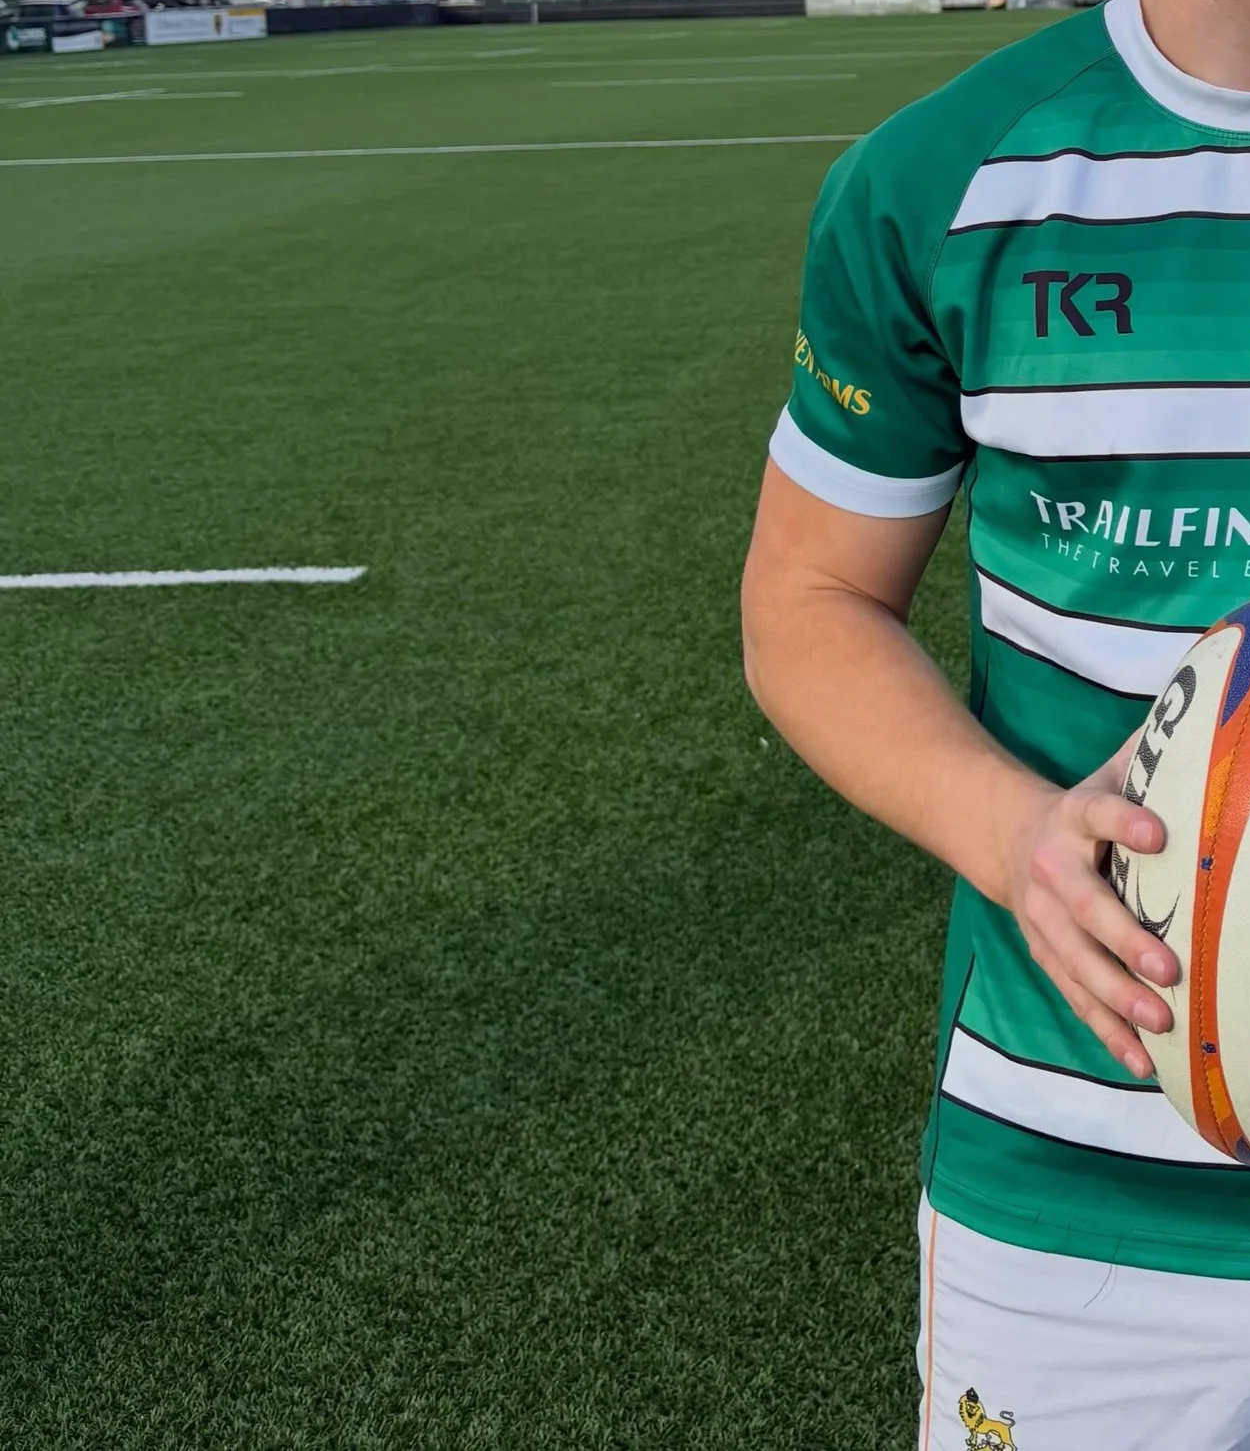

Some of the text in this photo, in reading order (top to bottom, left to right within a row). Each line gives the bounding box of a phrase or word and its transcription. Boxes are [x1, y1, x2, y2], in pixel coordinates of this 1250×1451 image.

[1022, 270, 1134, 338] TKR
[1041, 533, 1084, 561] THE
[1092, 552, 1220, 578] TRAVEL
